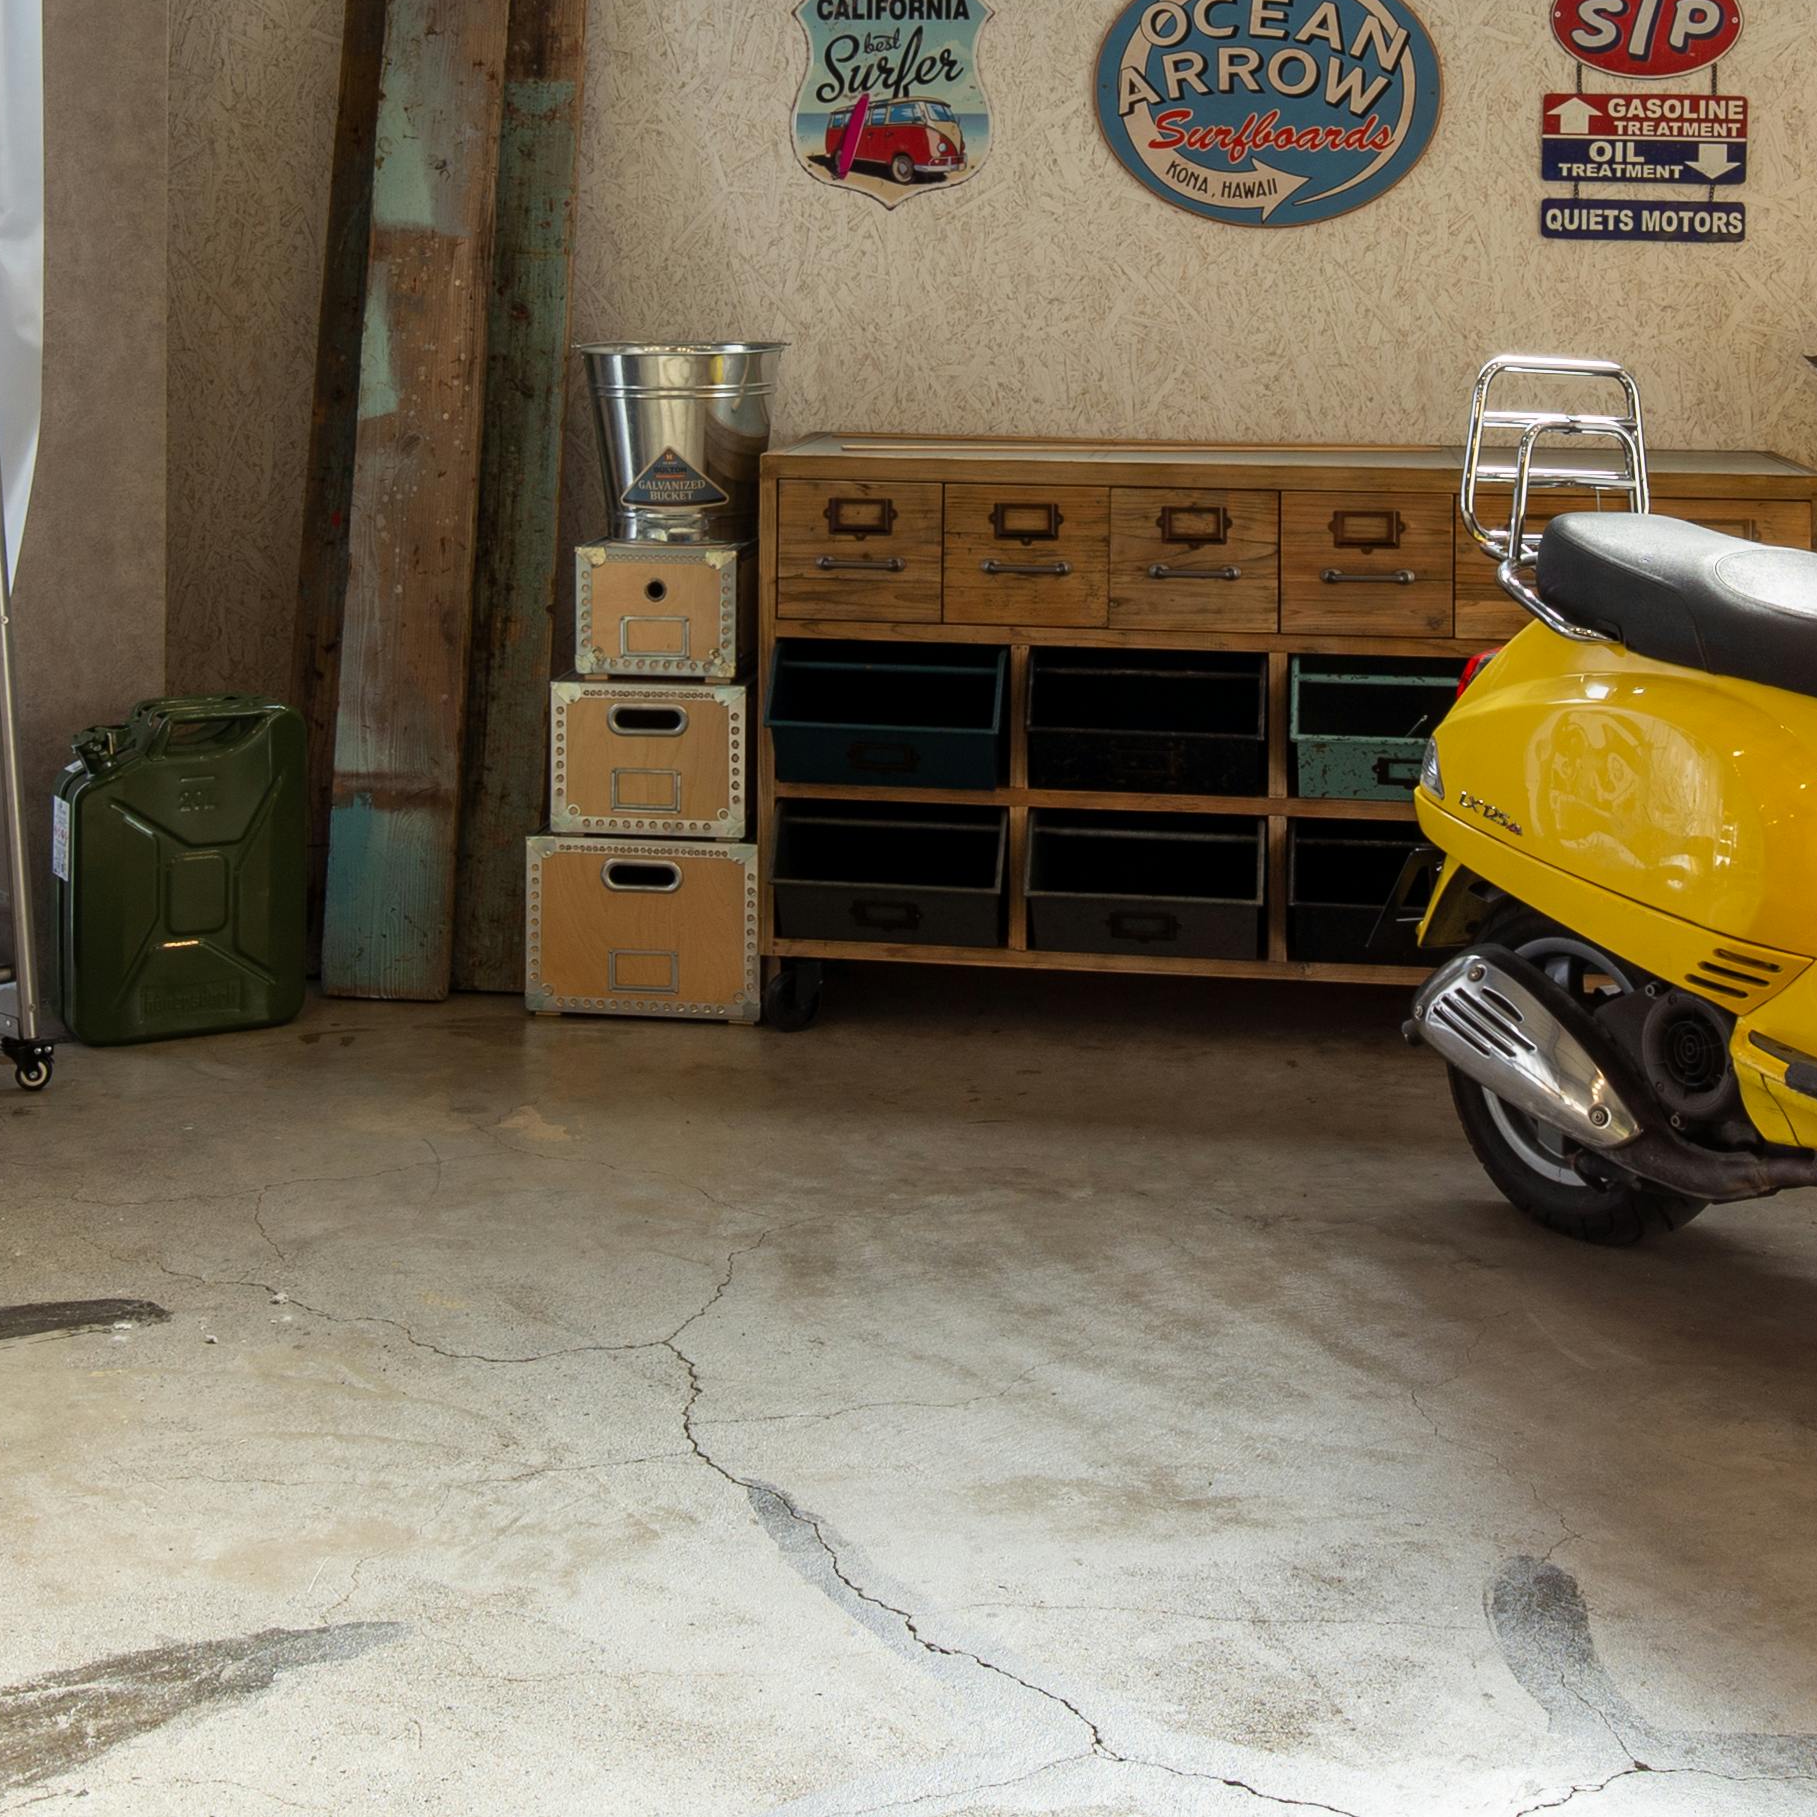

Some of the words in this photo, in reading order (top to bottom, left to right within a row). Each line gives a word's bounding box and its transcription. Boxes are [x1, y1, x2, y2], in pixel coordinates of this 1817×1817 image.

[863, 28, 901, 54] best
[815, 25, 964, 103] Surfer
[1118, 46, 1398, 118] ARROW
[1607, 98, 1744, 121] GASOLINE
[1147, 109, 1395, 163] Surfboards
[1614, 121, 1741, 138] TREATMENT
[1589, 141, 1645, 163] OIL
[1558, 163, 1684, 179] TREATMENT
[1221, 178, 1278, 199] HAWAII
[1545, 208, 1634, 232] QUIETS
[1641, 210, 1744, 234] MOTORS
[638, 480, 706, 490] GALVANIZED
[650, 490, 695, 501] BUCKET
